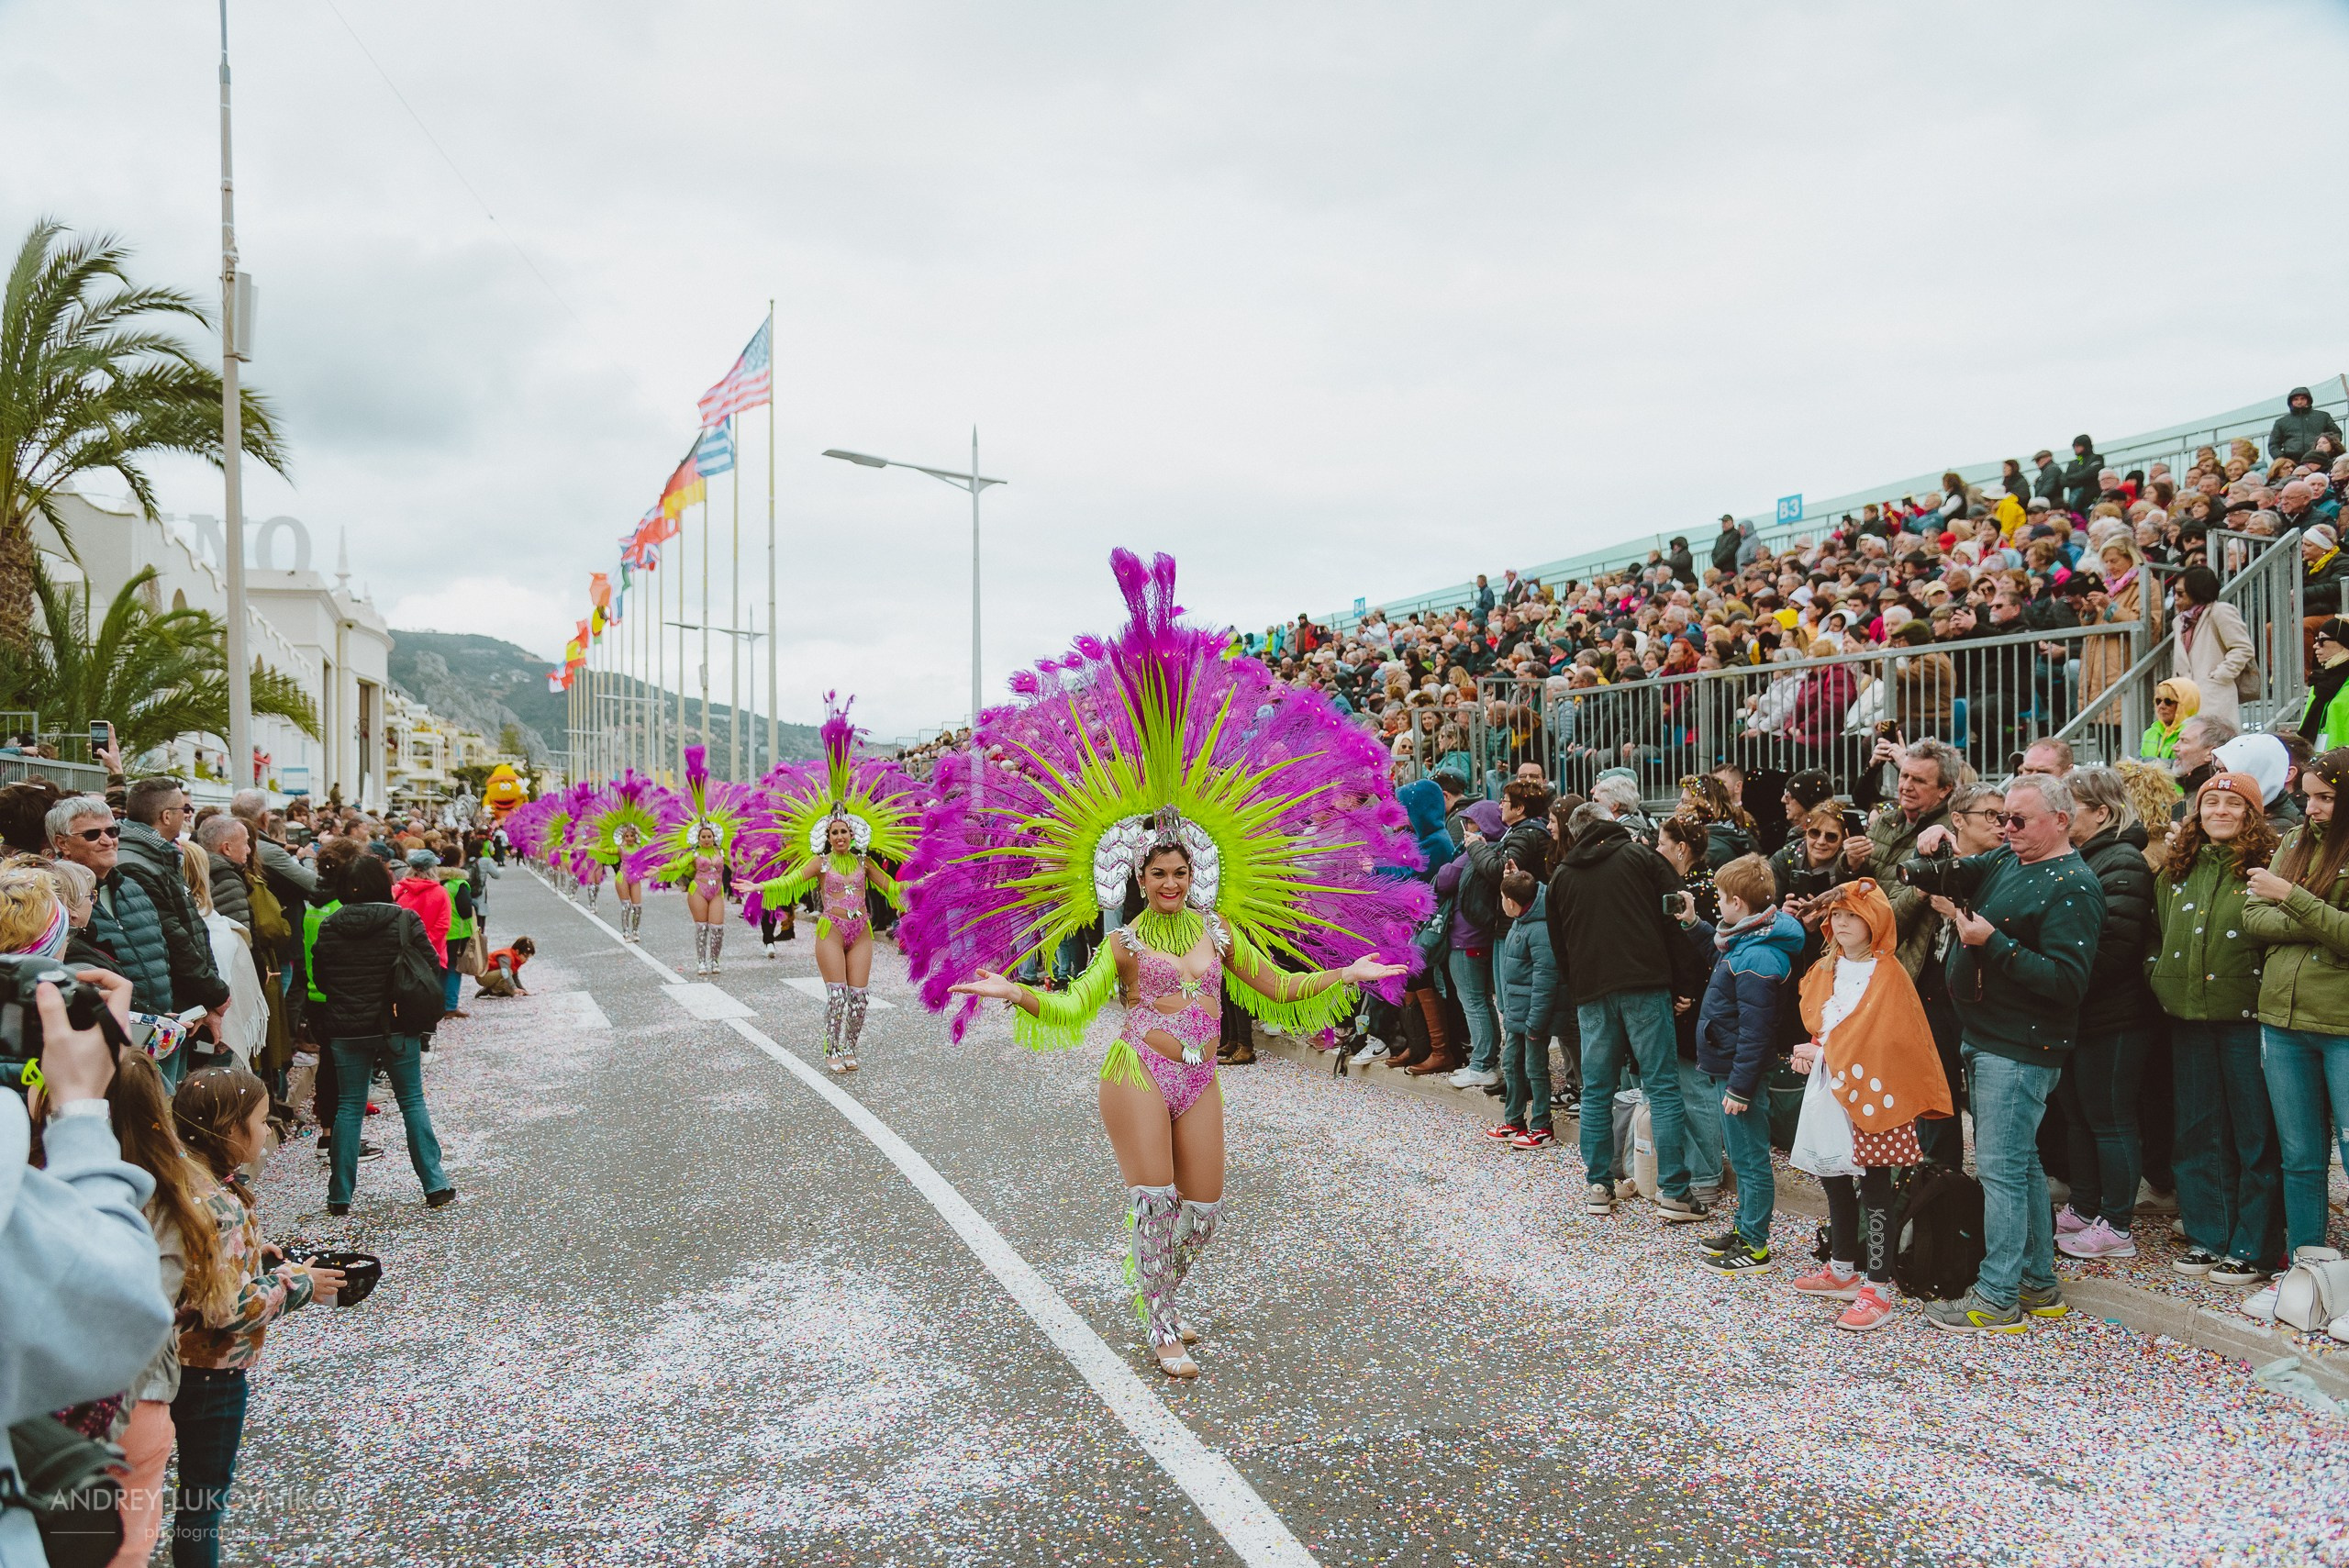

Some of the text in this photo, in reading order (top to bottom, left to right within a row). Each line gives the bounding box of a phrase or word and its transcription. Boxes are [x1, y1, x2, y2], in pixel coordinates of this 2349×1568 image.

[1780, 498, 1799, 519] B3
[161, 513, 311, 571] NO
[1868, 1207, 1887, 1270] Kappa
